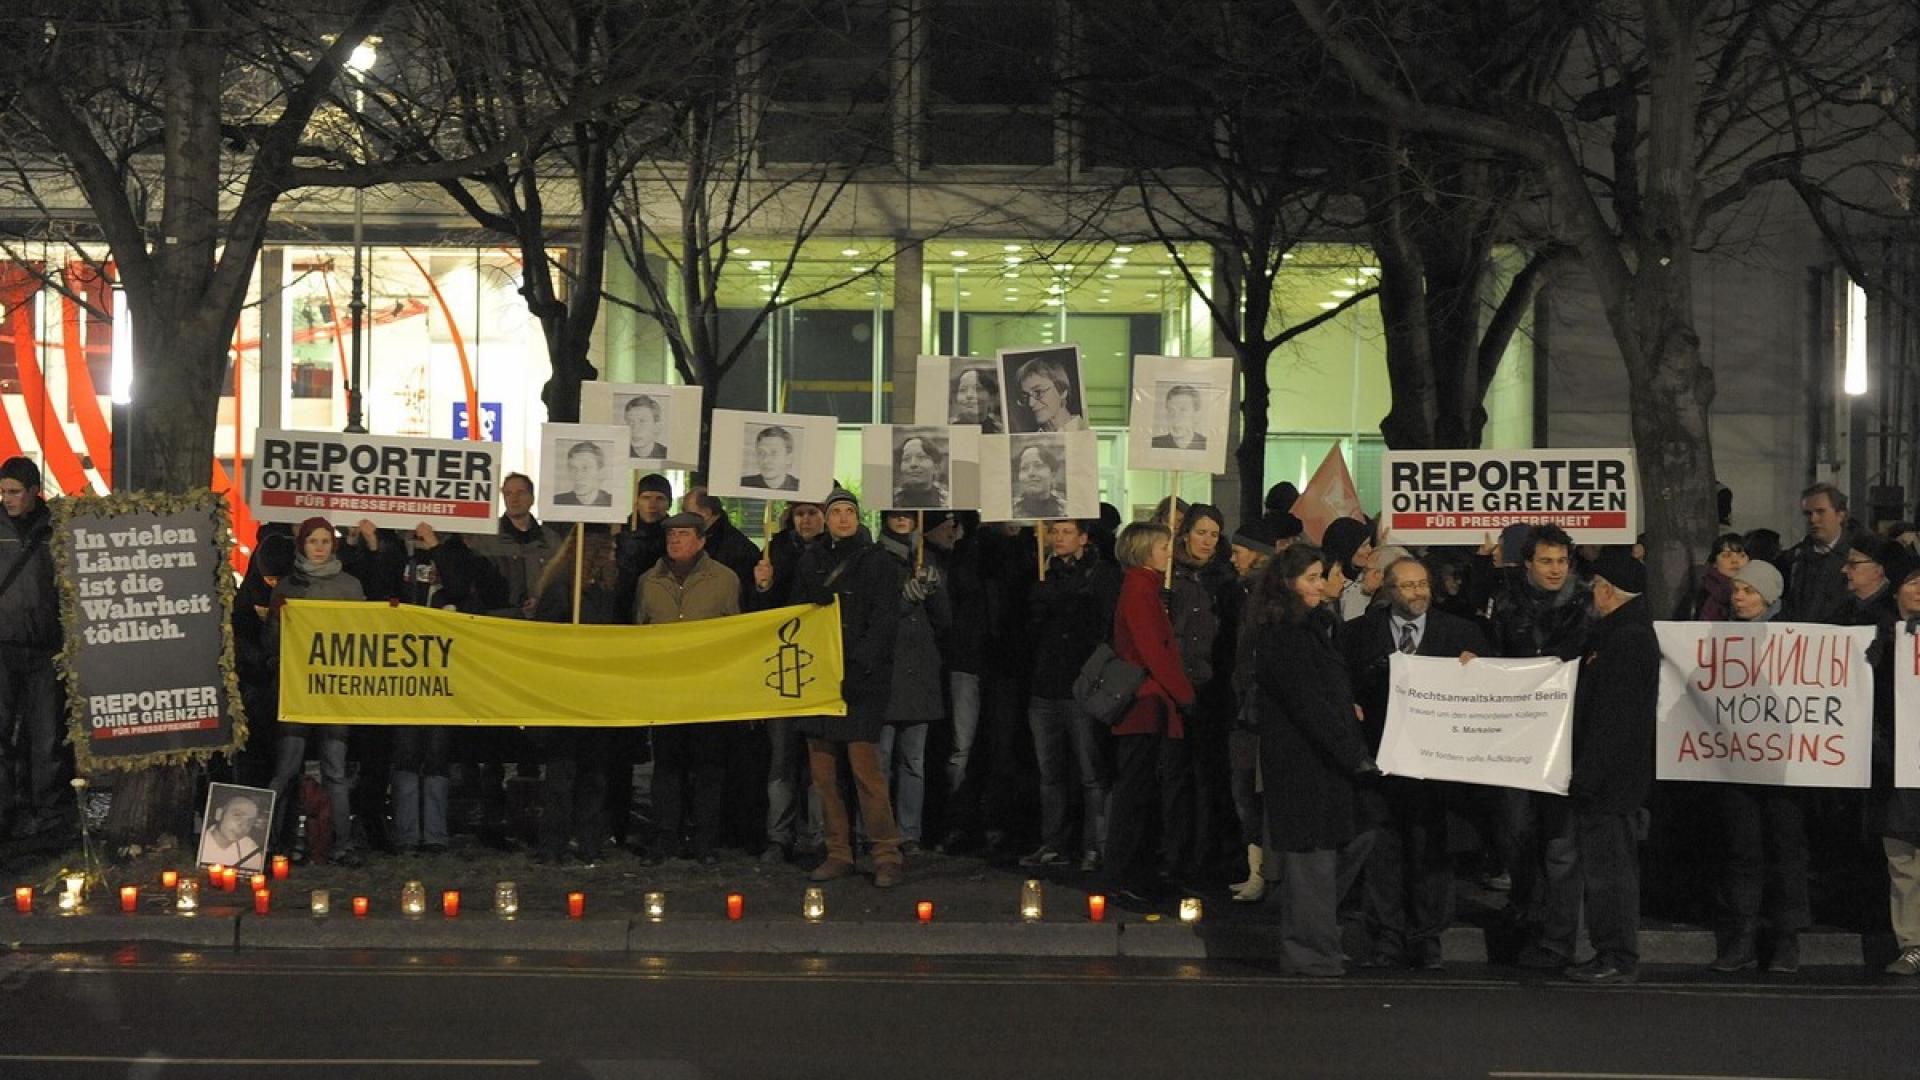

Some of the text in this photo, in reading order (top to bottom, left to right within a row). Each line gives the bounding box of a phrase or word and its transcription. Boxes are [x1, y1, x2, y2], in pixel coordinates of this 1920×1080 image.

[263, 439, 492, 481] REPORTER
[262, 470, 491, 501] OHNE GRENZEN
[1392, 460, 1626, 492] REPORTER
[295, 494, 457, 514] FÜR PRESSEFREIHEIT
[1392, 492, 1626, 512] OHNE GRENZEN
[1426, 514, 1456, 528] FÜR
[73, 524, 197, 550] In vielen
[75, 549, 197, 574] Ländern
[79, 572, 164, 597] ist die
[80, 594, 212, 621] Wahrheit
[83, 618, 186, 645] tödlich.
[308, 631, 454, 668] AMNESTY
[1696, 627, 1850, 691] УБИЙЦЫ
[308, 673, 455, 697] INTERNATIONAL
[1408, 688, 1533, 703] Rechtsanwaltskammer
[1535, 690, 1568, 701] Berlin
[89, 686, 217, 716] REPORTER
[1715, 693, 1844, 727] MÖRDER
[92, 704, 219, 729] OHNE GRENZEN
[1678, 731, 1846, 766] ASSASSINS
